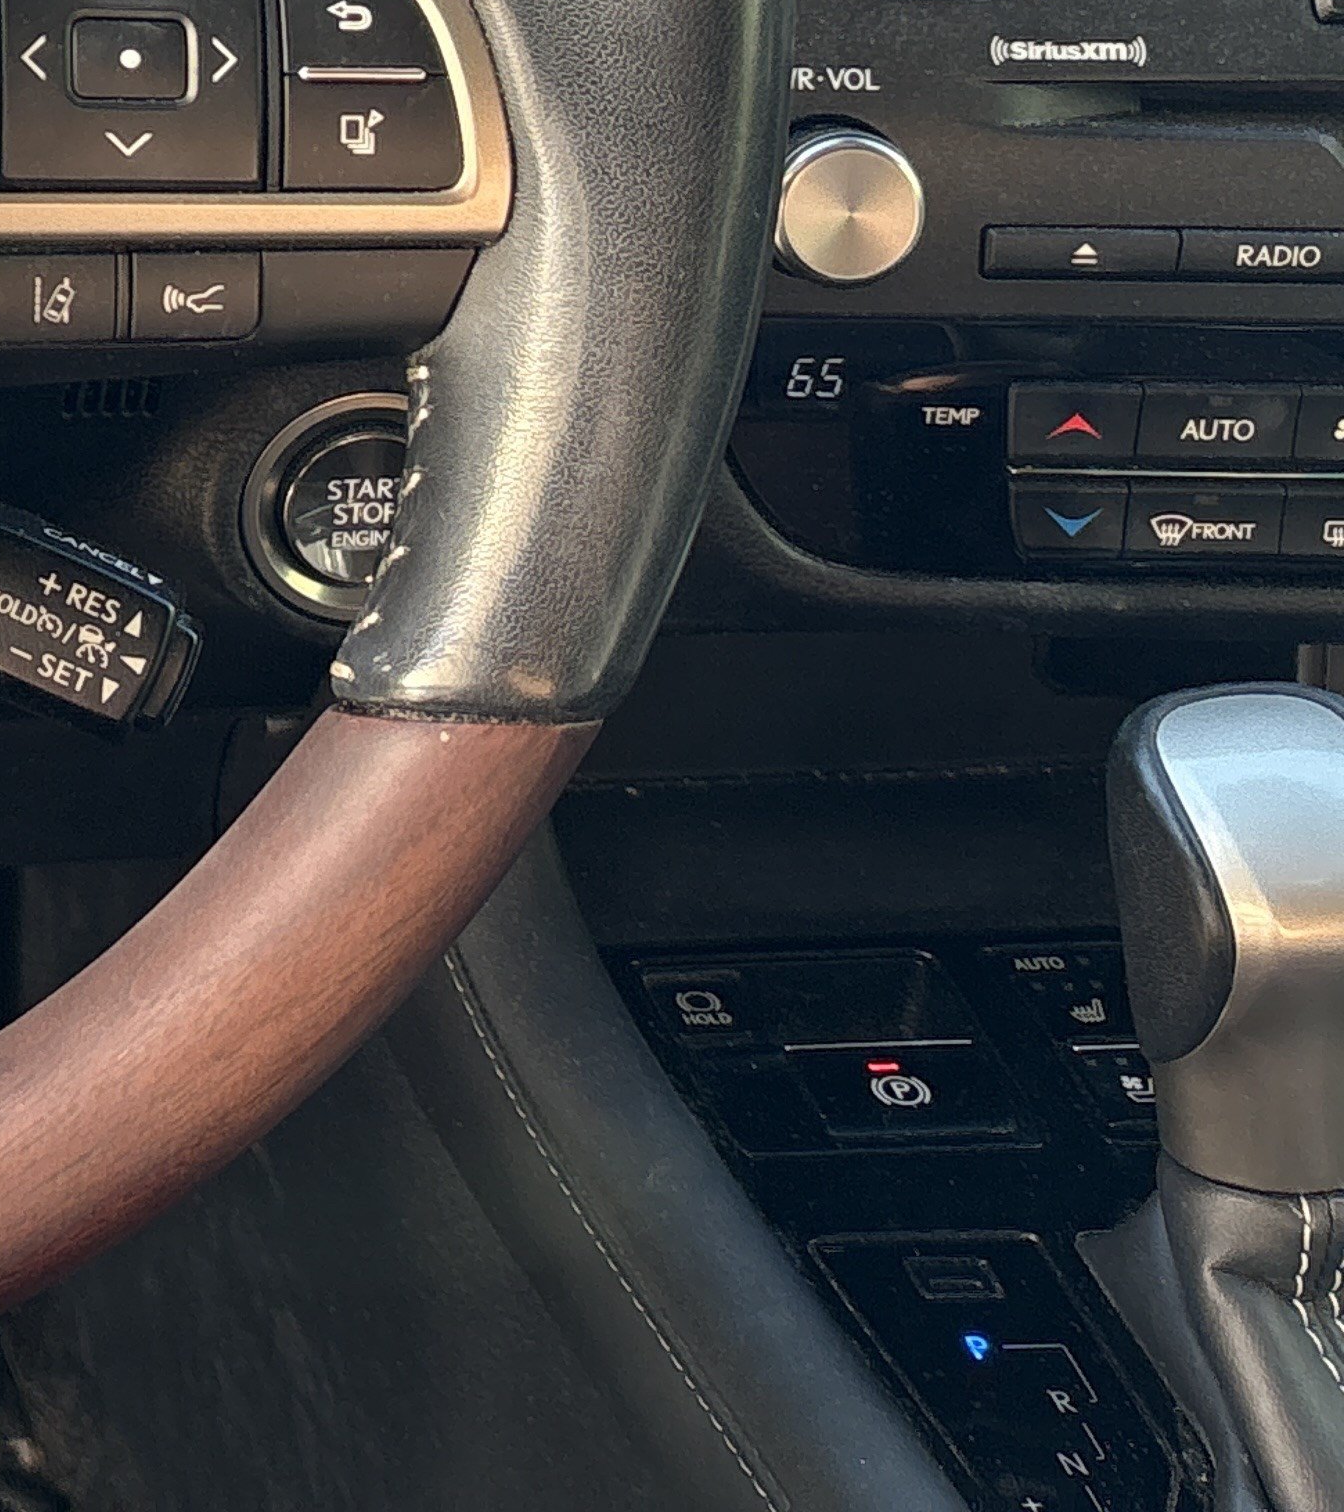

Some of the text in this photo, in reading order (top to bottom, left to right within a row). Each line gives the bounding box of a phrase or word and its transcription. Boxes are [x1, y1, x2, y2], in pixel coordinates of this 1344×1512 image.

[1236, 244, 1322, 269] RADIO
[785, 356, 845, 399] 65
[922, 405, 981, 426] TEMP
[1179, 418, 1255, 441] AUTO
[332, 529, 391, 549] ENGIN
[1191, 522, 1257, 541] FRONT
[43, 526, 145, 581] CANCEL
[65, 581, 121, 625] RES
[36, 652, 94, 693] SET
[1014, 956, 1066, 972] AUTO
[964, 1335, 990, 1361] P
[1046, 1388, 1079, 1415] R
[1056, 1452, 1090, 1477] N
